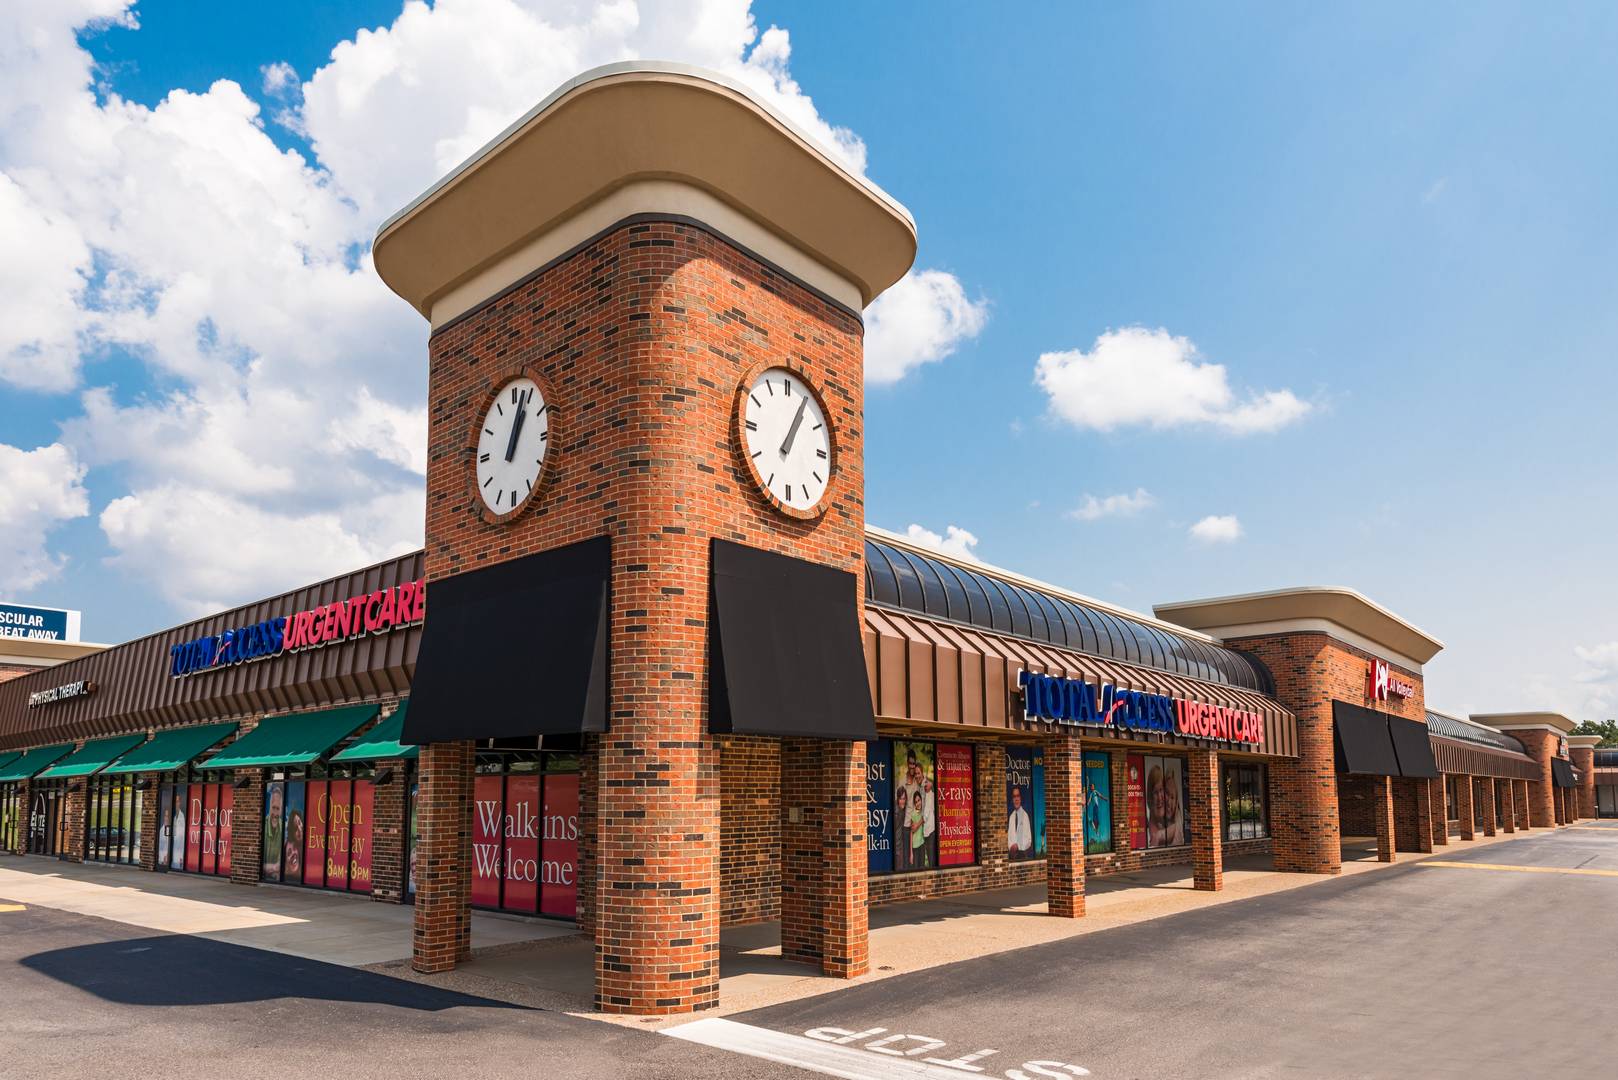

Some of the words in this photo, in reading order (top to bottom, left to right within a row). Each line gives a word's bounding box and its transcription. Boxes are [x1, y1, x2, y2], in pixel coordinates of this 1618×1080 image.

[283, 578, 425, 651] URGENTCARE
[27, 628, 58, 641] AWAY
[59, 680, 85, 700] THERAPY
[1018, 669, 1106, 724] TOTAL
[1175, 698, 1264, 744] URGENTCARE
[867, 761, 886, 781] ast
[938, 787, 972, 806] x-rays
[191, 798, 233, 827] Doctor
[317, 792, 364, 832] Open
[867, 808, 889, 834] asy
[868, 834, 890, 851] lk-in
[939, 820, 972, 839] Physicals
[203, 830, 228, 862] Duty
[472, 843, 573, 886] Welcome
[804, 1026, 1091, 1080] STOP
